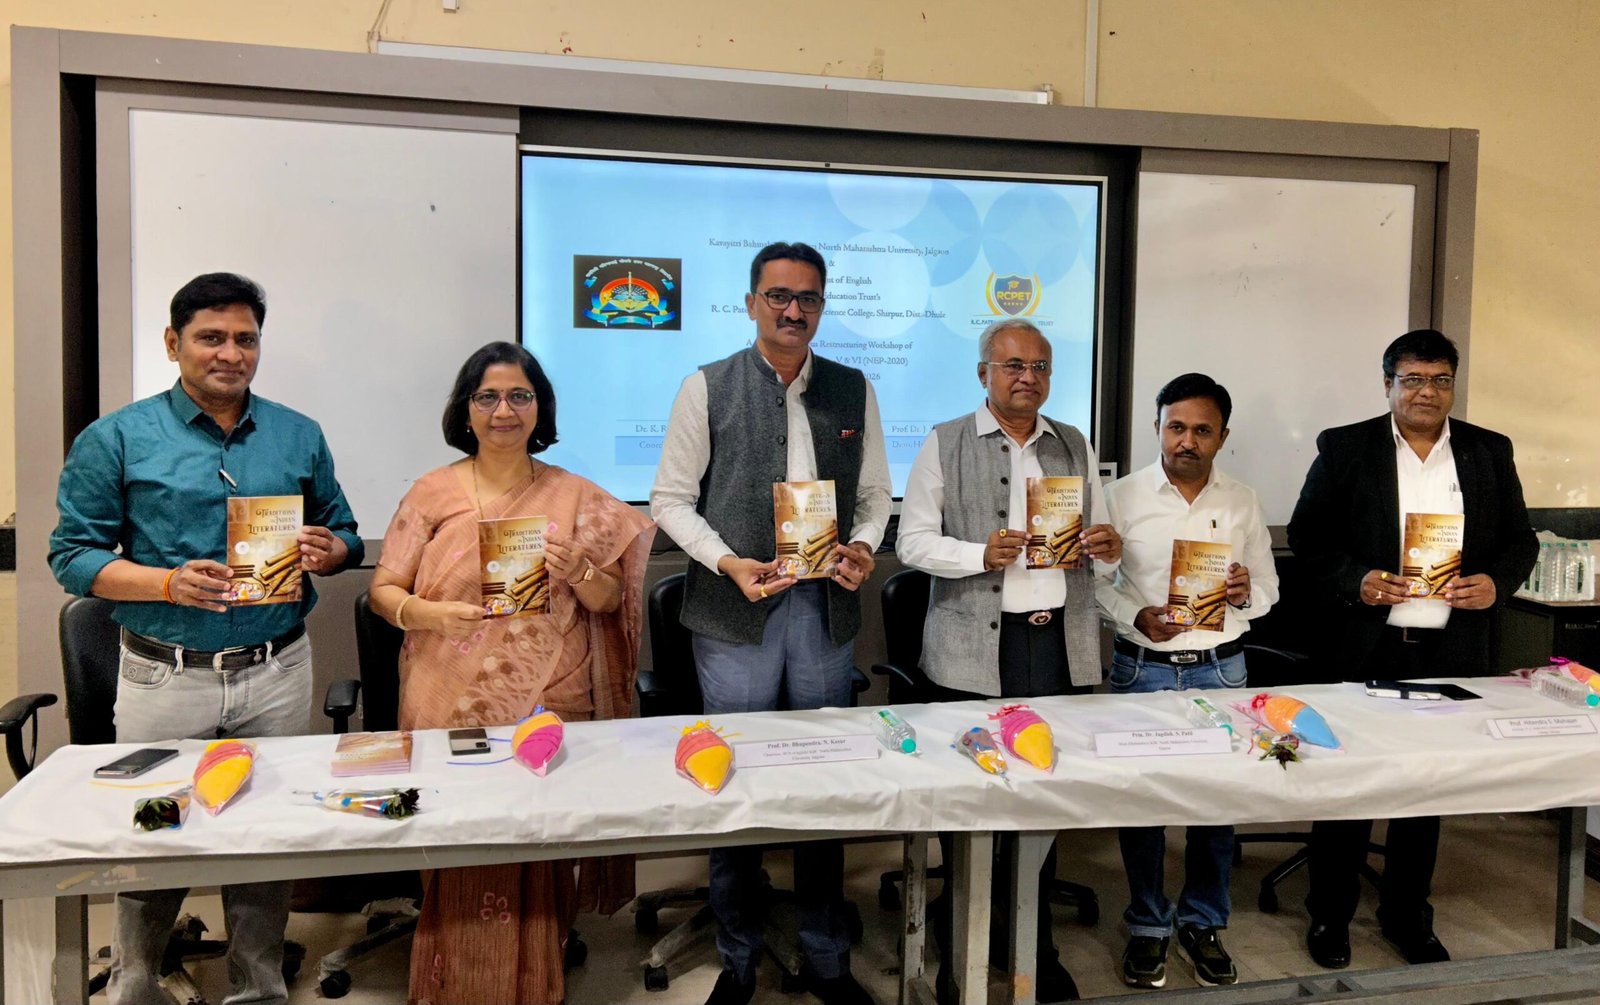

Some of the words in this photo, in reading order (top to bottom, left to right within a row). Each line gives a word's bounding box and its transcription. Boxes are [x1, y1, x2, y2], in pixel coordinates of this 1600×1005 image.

[819, 243, 842, 251] North
[843, 244, 886, 253] Maharashtra
[888, 246, 924, 256] University,
[925, 247, 949, 257] Jalgaon
[835, 276, 844, 284] of
[846, 277, 872, 287] English
[858, 292, 881, 301] Trust's
[996, 291, 1032, 301] RCPET
[711, 305, 720, 313] R.
[722, 305, 731, 313] C.
[847, 309, 875, 319] College,
[876, 309, 905, 319] Shirpur,
[820, 341, 867, 351] Restructuring
[868, 341, 903, 351] Workshop
[904, 341, 914, 349] of
[851, 356, 862, 364] VI
[863, 356, 909, 366] (NEP-2020)
[635, 424, 648, 433] Dr.
[650, 424, 659, 433] K.
[892, 425, 909, 433] Prof.
[910, 425, 921, 433] Dr.
